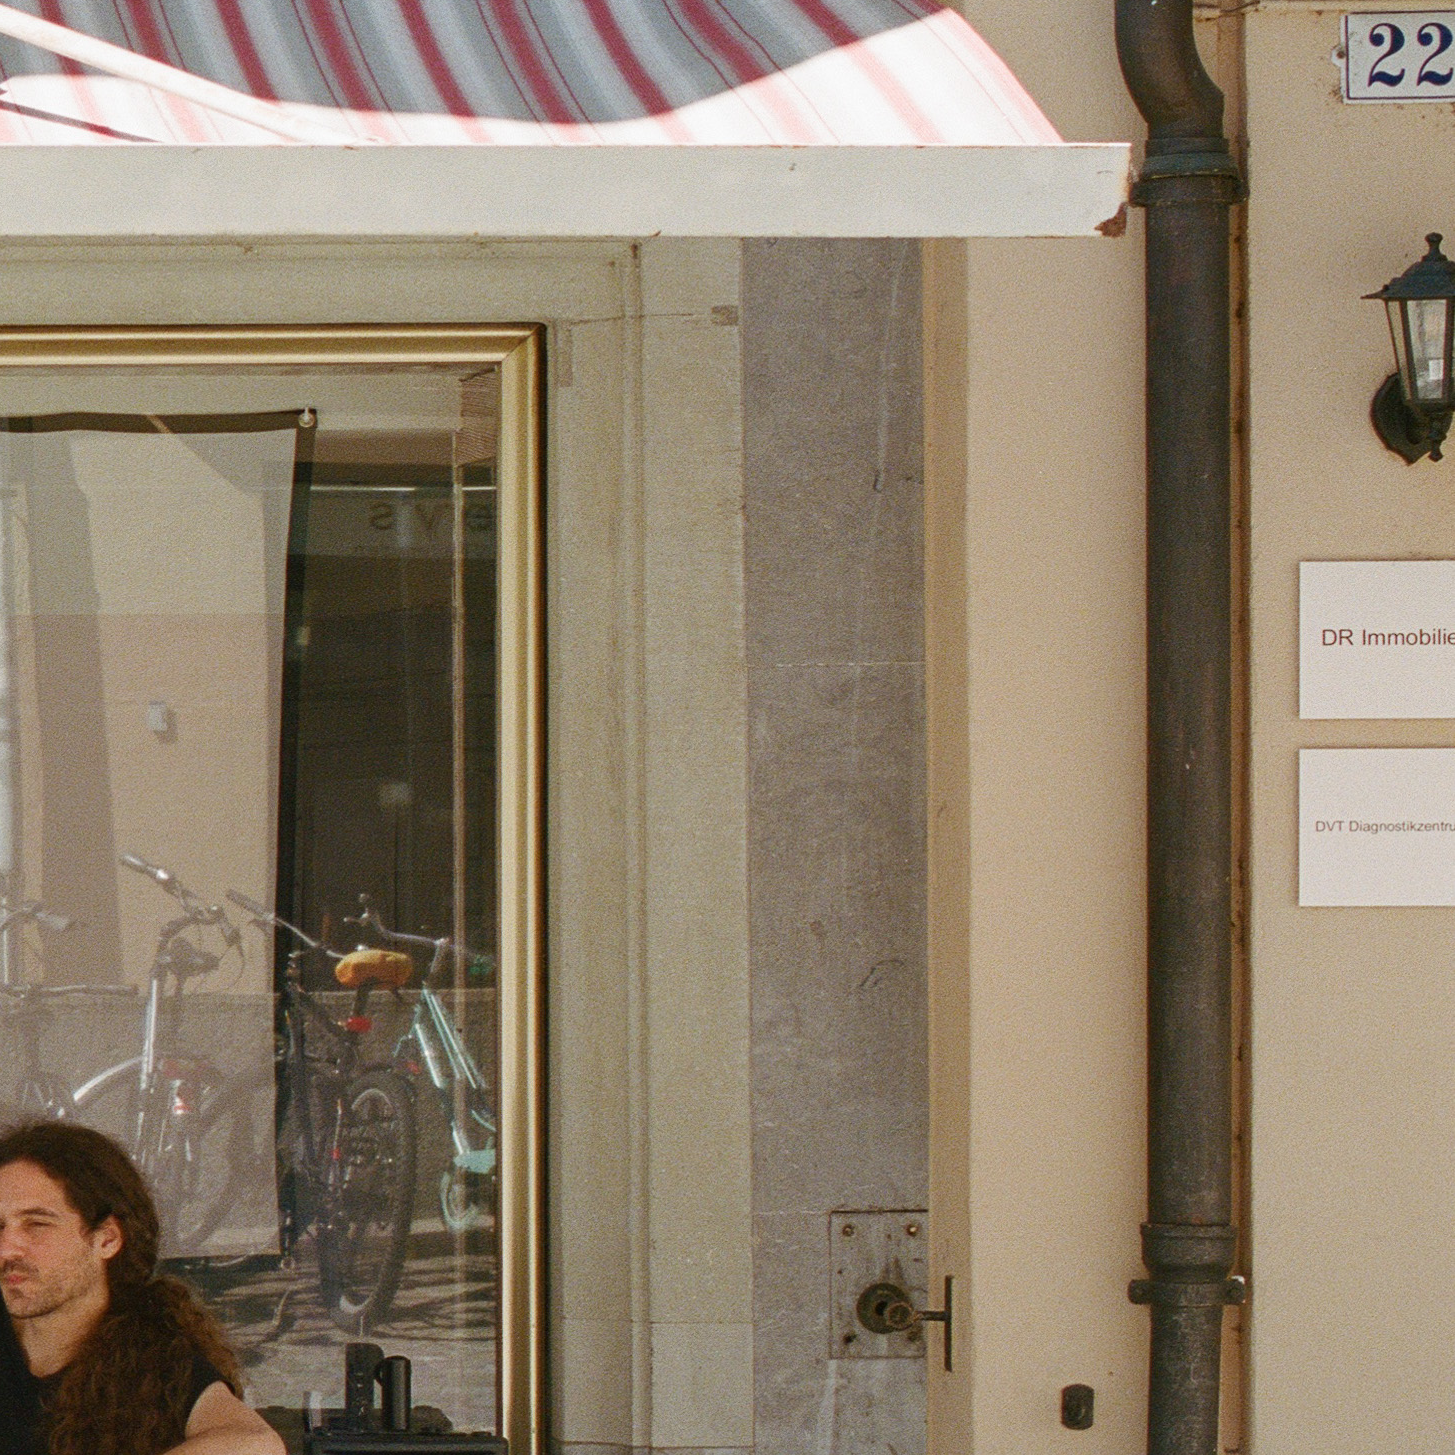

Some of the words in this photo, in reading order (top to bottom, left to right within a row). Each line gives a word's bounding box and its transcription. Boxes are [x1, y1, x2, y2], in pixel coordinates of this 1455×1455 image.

[1368, 22, 1454, 88] 22
[1322, 629, 1353, 645] DR
[1316, 820, 1344, 832] DVT
